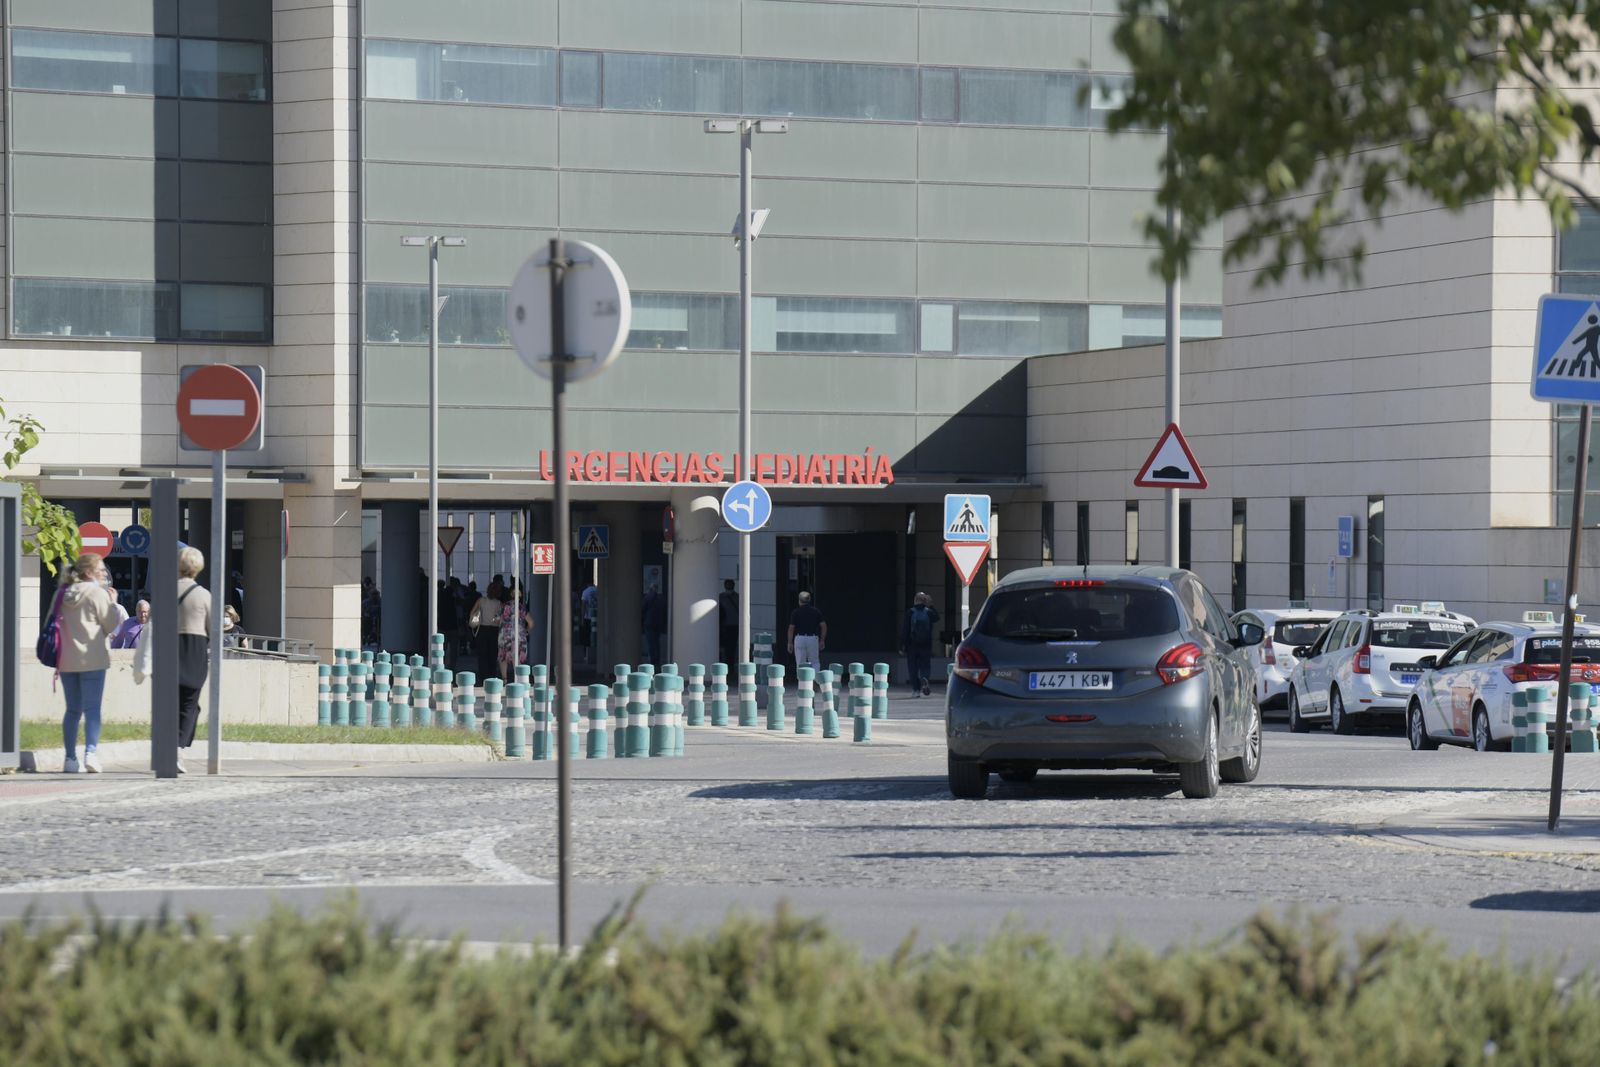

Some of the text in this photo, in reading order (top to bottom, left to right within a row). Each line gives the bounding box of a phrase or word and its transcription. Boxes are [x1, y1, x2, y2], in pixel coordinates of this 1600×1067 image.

[539, 448, 724, 482] URGENCIAS
[1039, 674, 1111, 687] 4471 KBW
